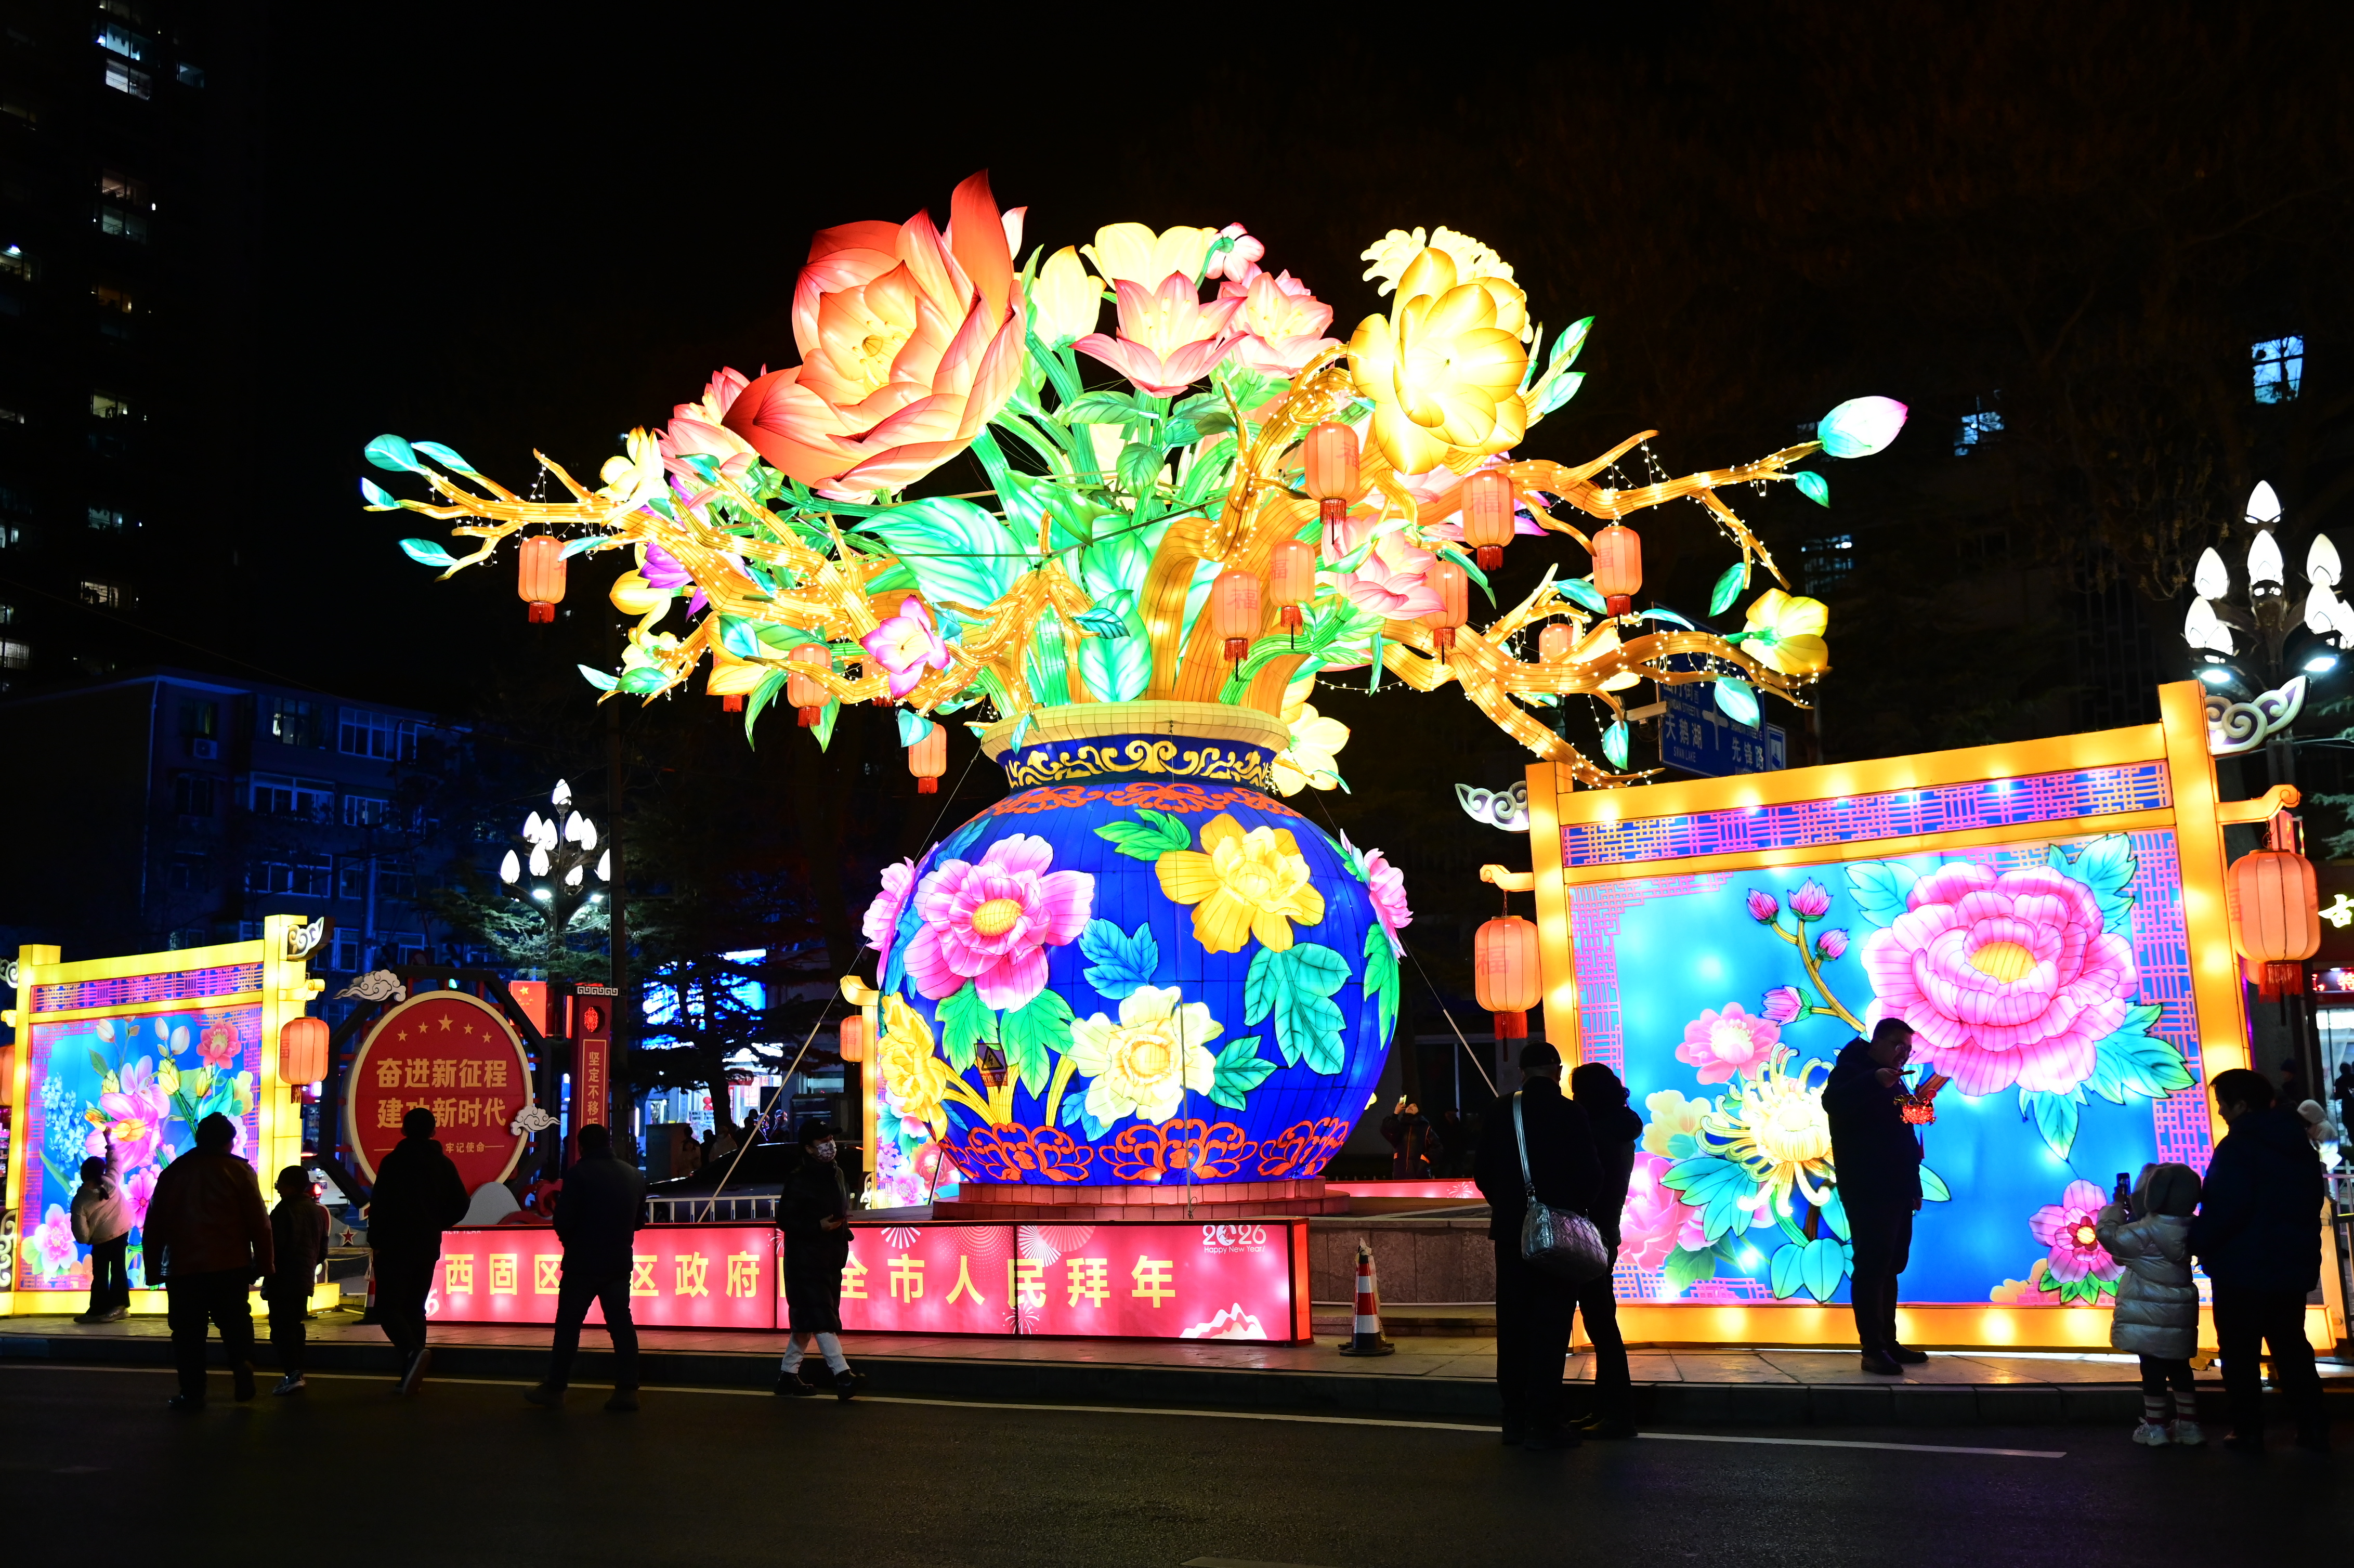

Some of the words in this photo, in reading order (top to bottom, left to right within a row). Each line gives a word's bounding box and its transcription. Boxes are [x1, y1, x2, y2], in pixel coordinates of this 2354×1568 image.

[1469, 491, 1502, 515] 福
[1270, 559, 1289, 581] 福
[1227, 589, 1258, 610] 福
[1665, 713, 1703, 750] 天鹅湖
[1731, 736, 1764, 770] 先锋路
[1476, 945, 1511, 976] 福
[376, 1058, 507, 1088] 奋进新征程
[446, 1142, 485, 1153] 牢记使命
[1202, 1224, 1267, 1246] 2026
[1204, 1246, 1227, 1254] Happy
[446, 1251, 1176, 1309] 西固区区政府全市人民拜年
